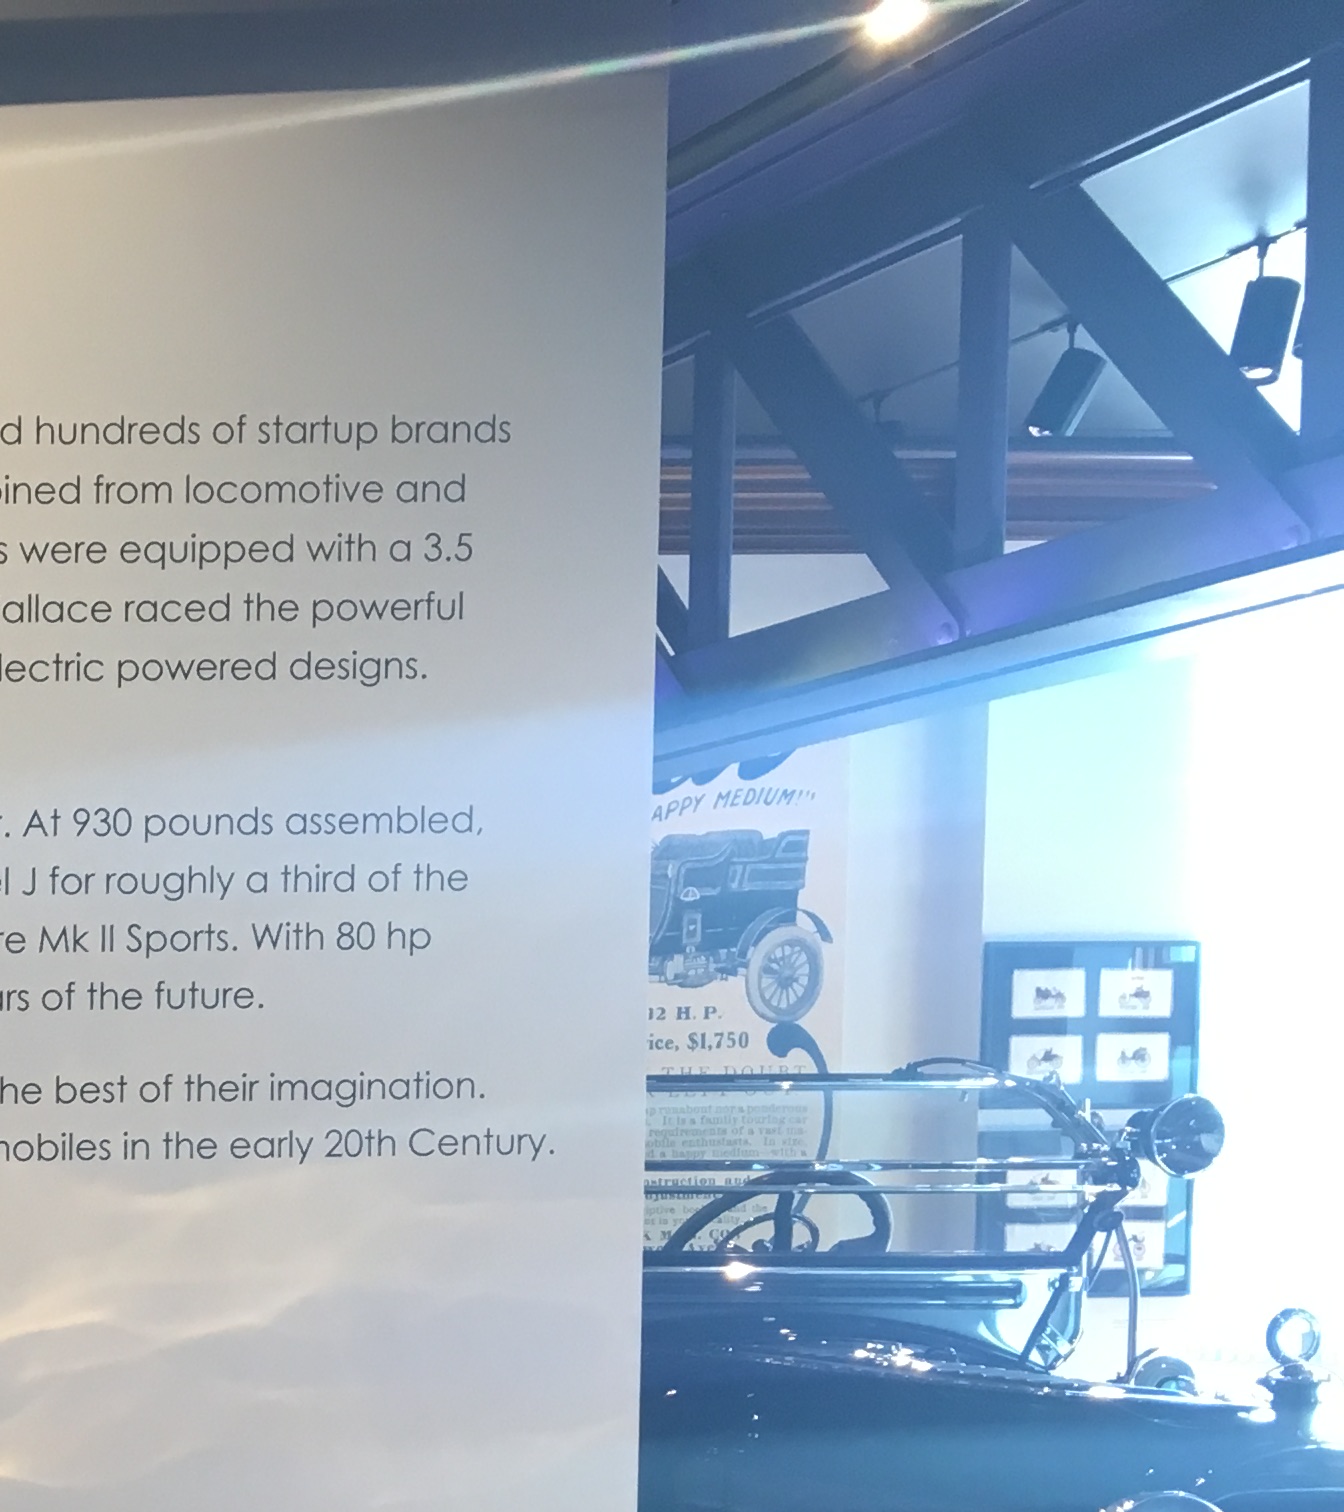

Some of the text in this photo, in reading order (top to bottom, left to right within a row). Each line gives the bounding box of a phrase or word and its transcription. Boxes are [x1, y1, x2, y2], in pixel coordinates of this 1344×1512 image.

[35, 414, 201, 446] hundreds
[212, 413, 247, 445] of
[257, 414, 378, 452] startup
[391, 413, 511, 444] brands
[117, 650, 277, 689] powered
[289, 649, 428, 688] designs.
[22, 808, 62, 838] At
[72, 807, 133, 838] 930
[144, 806, 274, 844] pounds
[285, 804, 483, 836] assembled,
[676, 1006, 696, 1020] H.
[703, 1006, 723, 1020] P.
[648, 1031, 749, 1052] ice, $1,750
[747, 1104, 808, 1116] ponderous
[700, 1115, 738, 1126] family
[742, 1116, 785, 1126] touring
[649, 1127, 727, 1139] requirements
[731, 1126, 744, 1135] of
[758, 1126, 783, 1135] vast
[122, 1131, 150, 1161] in
[162, 1131, 218, 1160] the
[229, 1129, 314, 1165] early
[324, 1128, 396, 1158] 20th
[408, 1127, 555, 1162] Century.
[764, 1137, 775, 1146] In
[672, 1149, 706, 1160] happy
[724, 1175, 751, 1186] and
